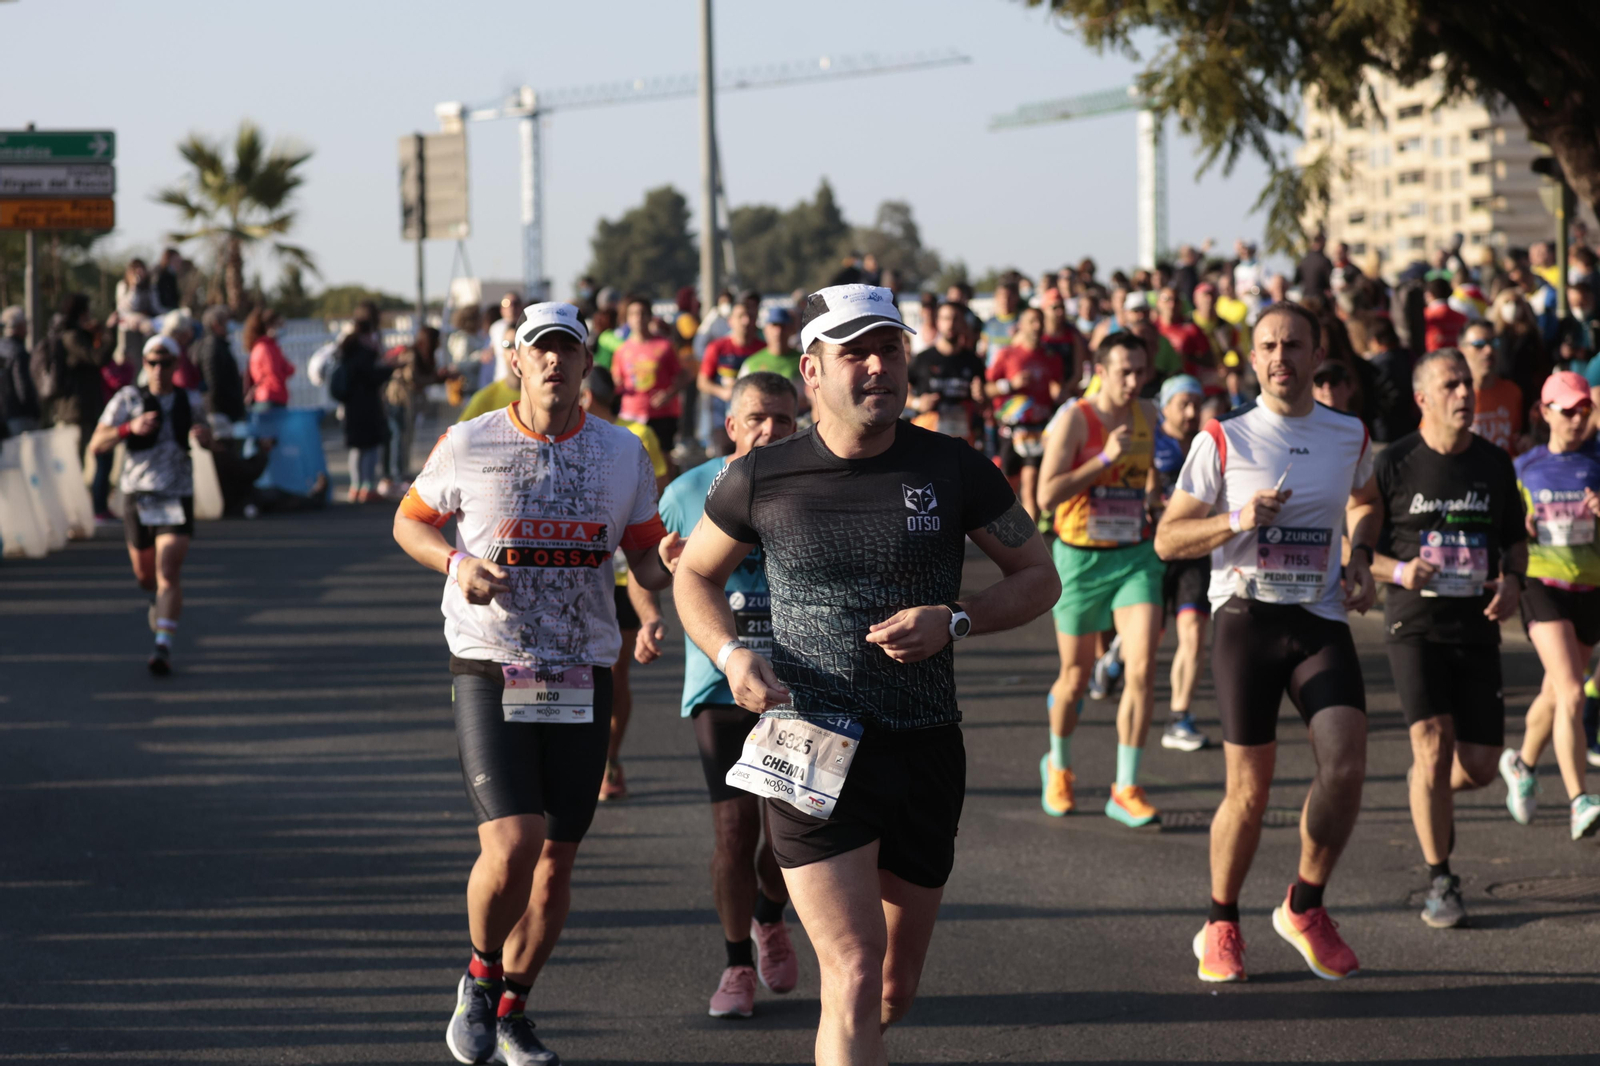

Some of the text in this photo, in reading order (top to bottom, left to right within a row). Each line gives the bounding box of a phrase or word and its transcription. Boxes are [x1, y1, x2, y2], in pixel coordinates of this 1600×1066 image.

[1289, 447, 1310, 455] FILA
[482, 464, 512, 473] COFIDES
[907, 515, 940, 531] OTSO
[521, 521, 587, 540] ROTA
[1284, 531, 1328, 543] ZURICH
[506, 548, 599, 567] D'OSSA
[1283, 554, 1310, 566] 7155
[1264, 572, 1294, 581] PEDRO
[747, 620, 773, 633] 213
[536, 691, 560, 701] NICO
[775, 729, 814, 755] 9325
[761, 754, 806, 781] CHEMA
